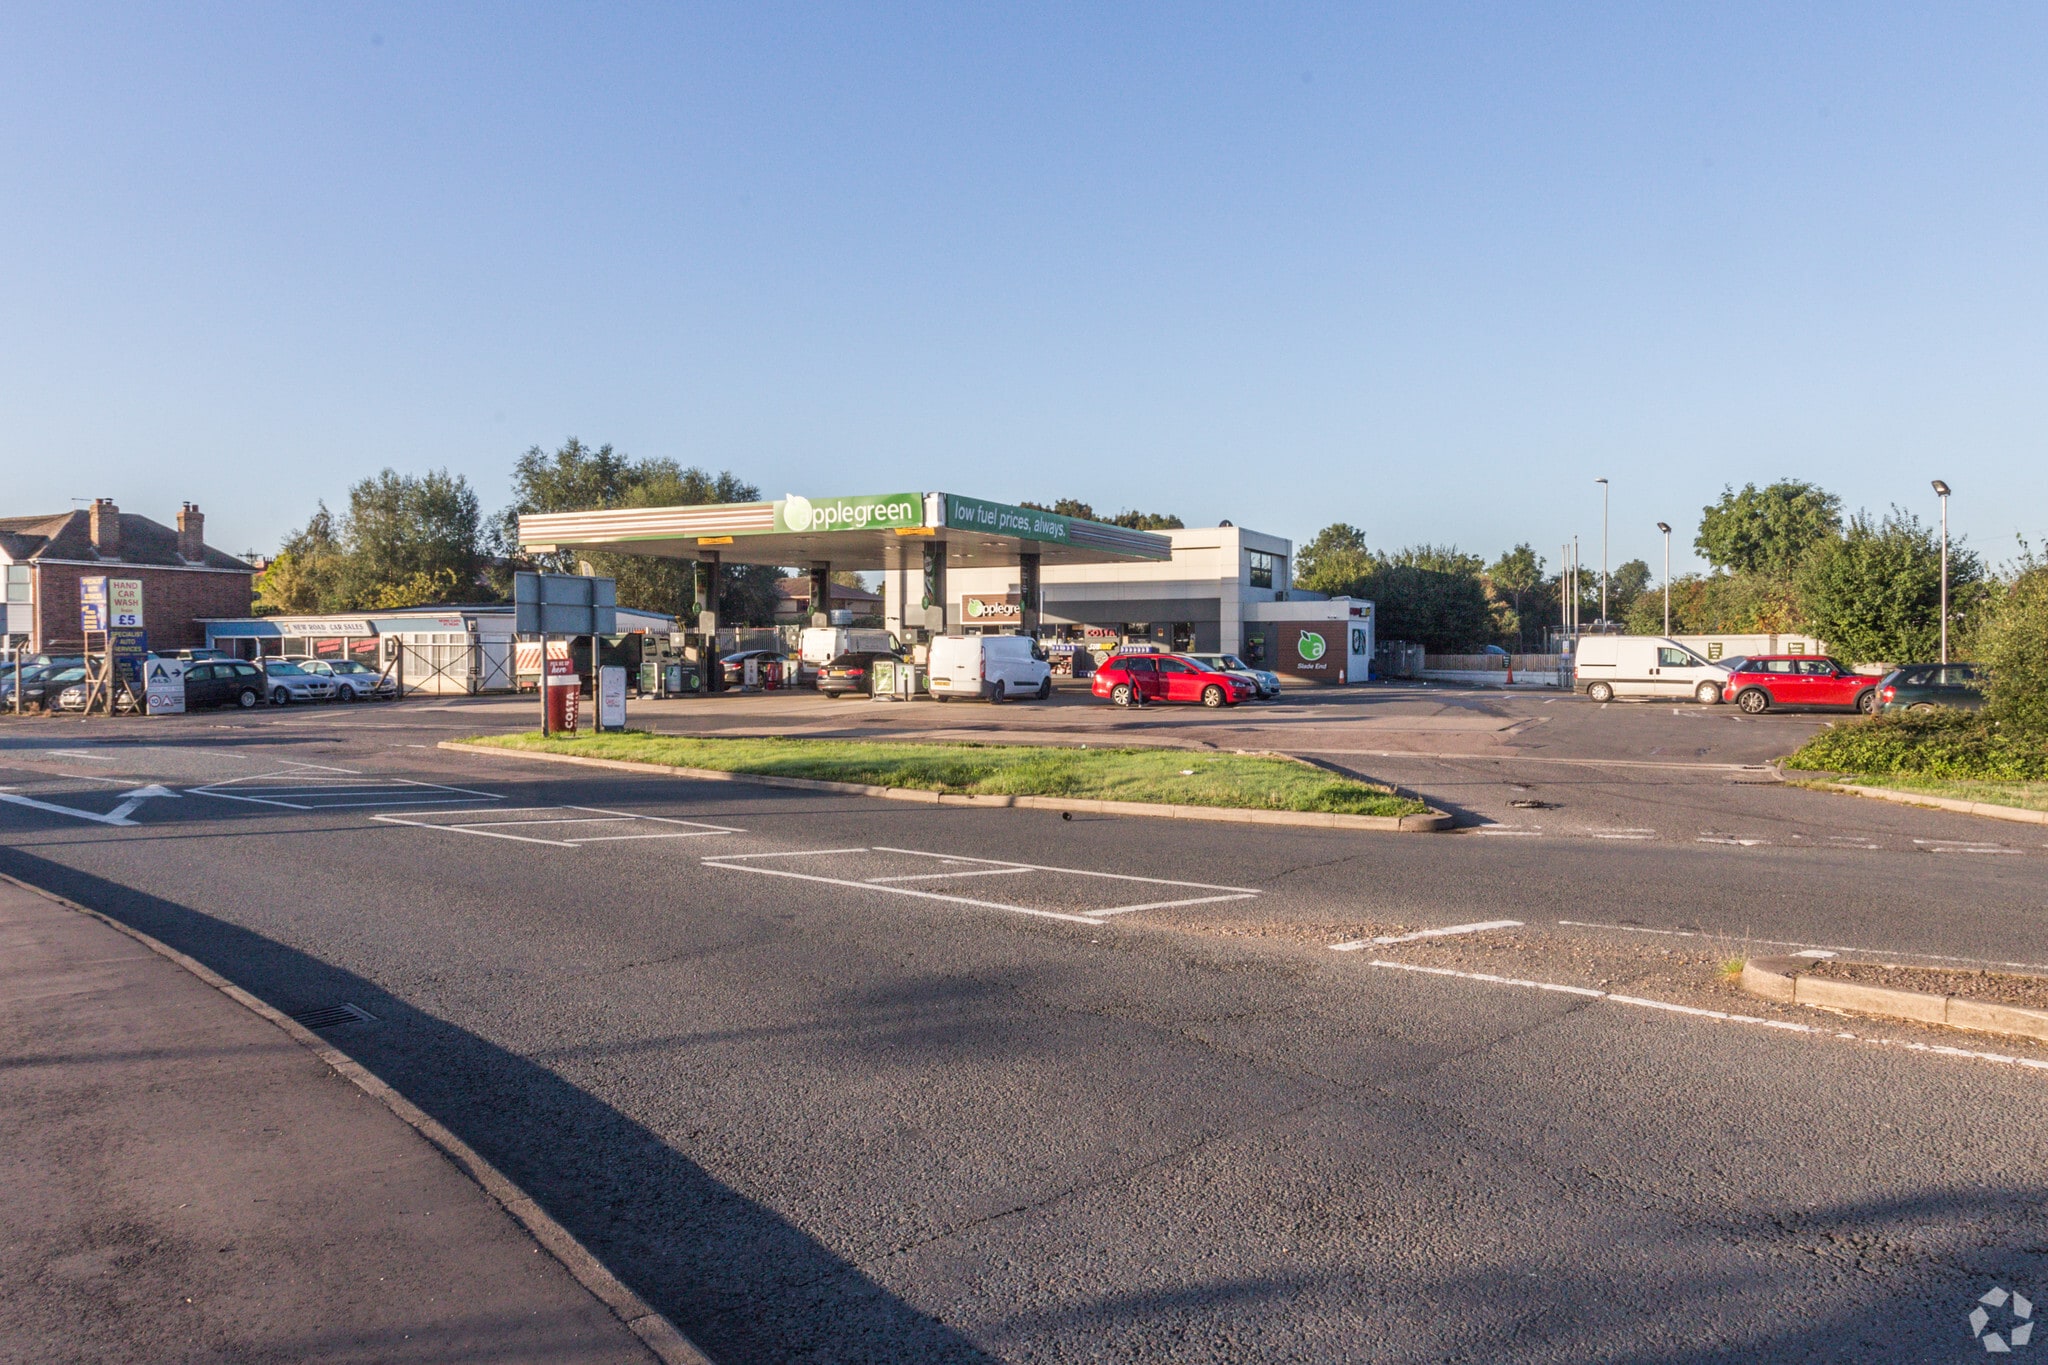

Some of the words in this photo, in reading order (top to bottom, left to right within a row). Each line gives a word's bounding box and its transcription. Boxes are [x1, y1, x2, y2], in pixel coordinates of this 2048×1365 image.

[954, 501, 975, 521] low
[977, 505, 998, 526] fuel
[999, 510, 1032, 533] prices,
[1034, 517, 1066, 539] always.
[113, 582, 138, 590] HAND
[117, 590, 135, 598] CAR
[974, 602, 1020, 617] applegre
[118, 614, 136, 625] £5
[1086, 627, 1117, 637] COSTA
[565, 692, 575, 729] COSTA
